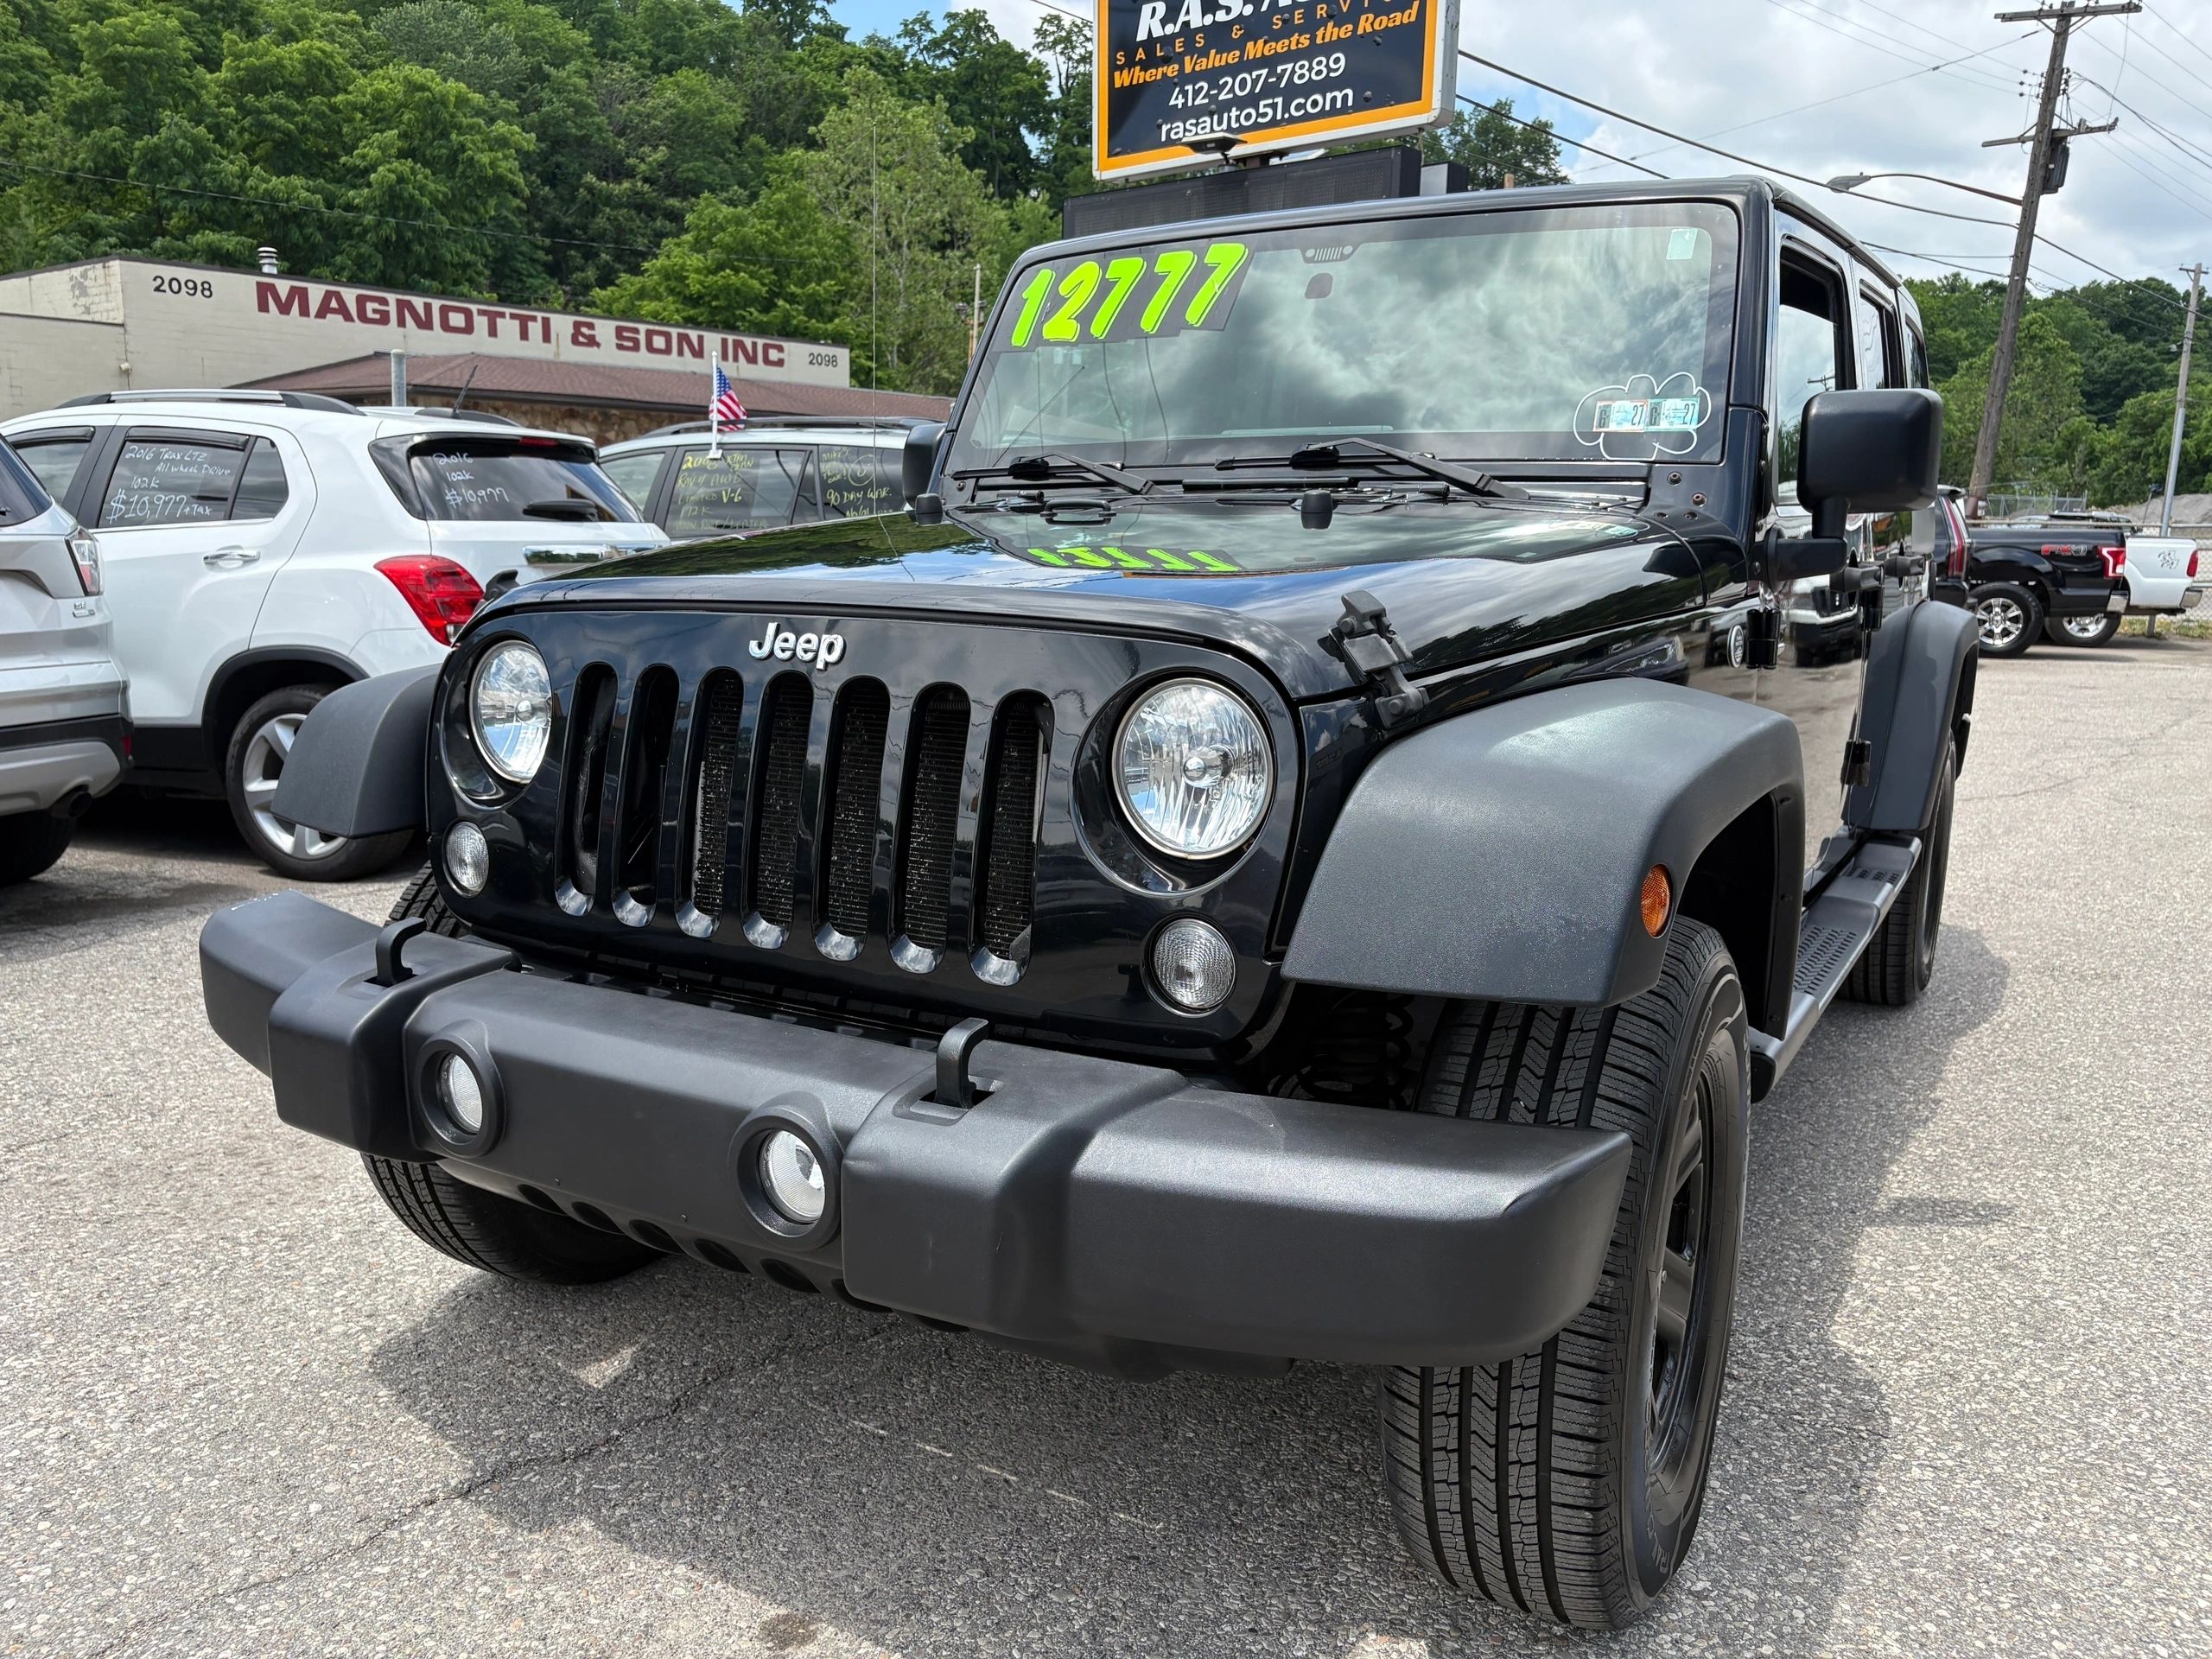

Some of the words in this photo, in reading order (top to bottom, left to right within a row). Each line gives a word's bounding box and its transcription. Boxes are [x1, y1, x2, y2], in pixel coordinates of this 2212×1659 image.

[1135, 0, 1255, 41] R.A.S.
[1114, 63, 1179, 89] Where
[1184, 50, 1240, 75] Value
[1243, 34, 1312, 61] Meets
[1315, 19, 1354, 45] the
[1357, 0, 1420, 35] Road
[1115, 33, 1205, 66] SALES
[1231, 24, 1244, 39] &
[1168, 52, 1346, 110] 412-207-7889
[1160, 87, 1355, 142] rasauto51.com
[152, 276, 213, 298] 2098
[1010, 243, 1249, 347] 12777
[255, 281, 552, 344] MAGNOTTI
[571, 320, 601, 349] &
[614, 325, 705, 359] SON
[721, 337, 785, 368] INC
[808, 353, 838, 368] 2098
[1631, 404, 1645, 426] 27
[1683, 403, 1696, 425] 27
[125, 445, 156, 461] 2016
[184, 449, 207, 461] LTZ
[155, 462, 169, 473] All
[433, 452, 474, 465] 2016
[105, 488, 187, 524] $10,977
[445, 486, 510, 509] $10,977
[827, 489, 841, 507] 90
[842, 490, 864, 505] DAY
[748, 621, 844, 671] Jeep
